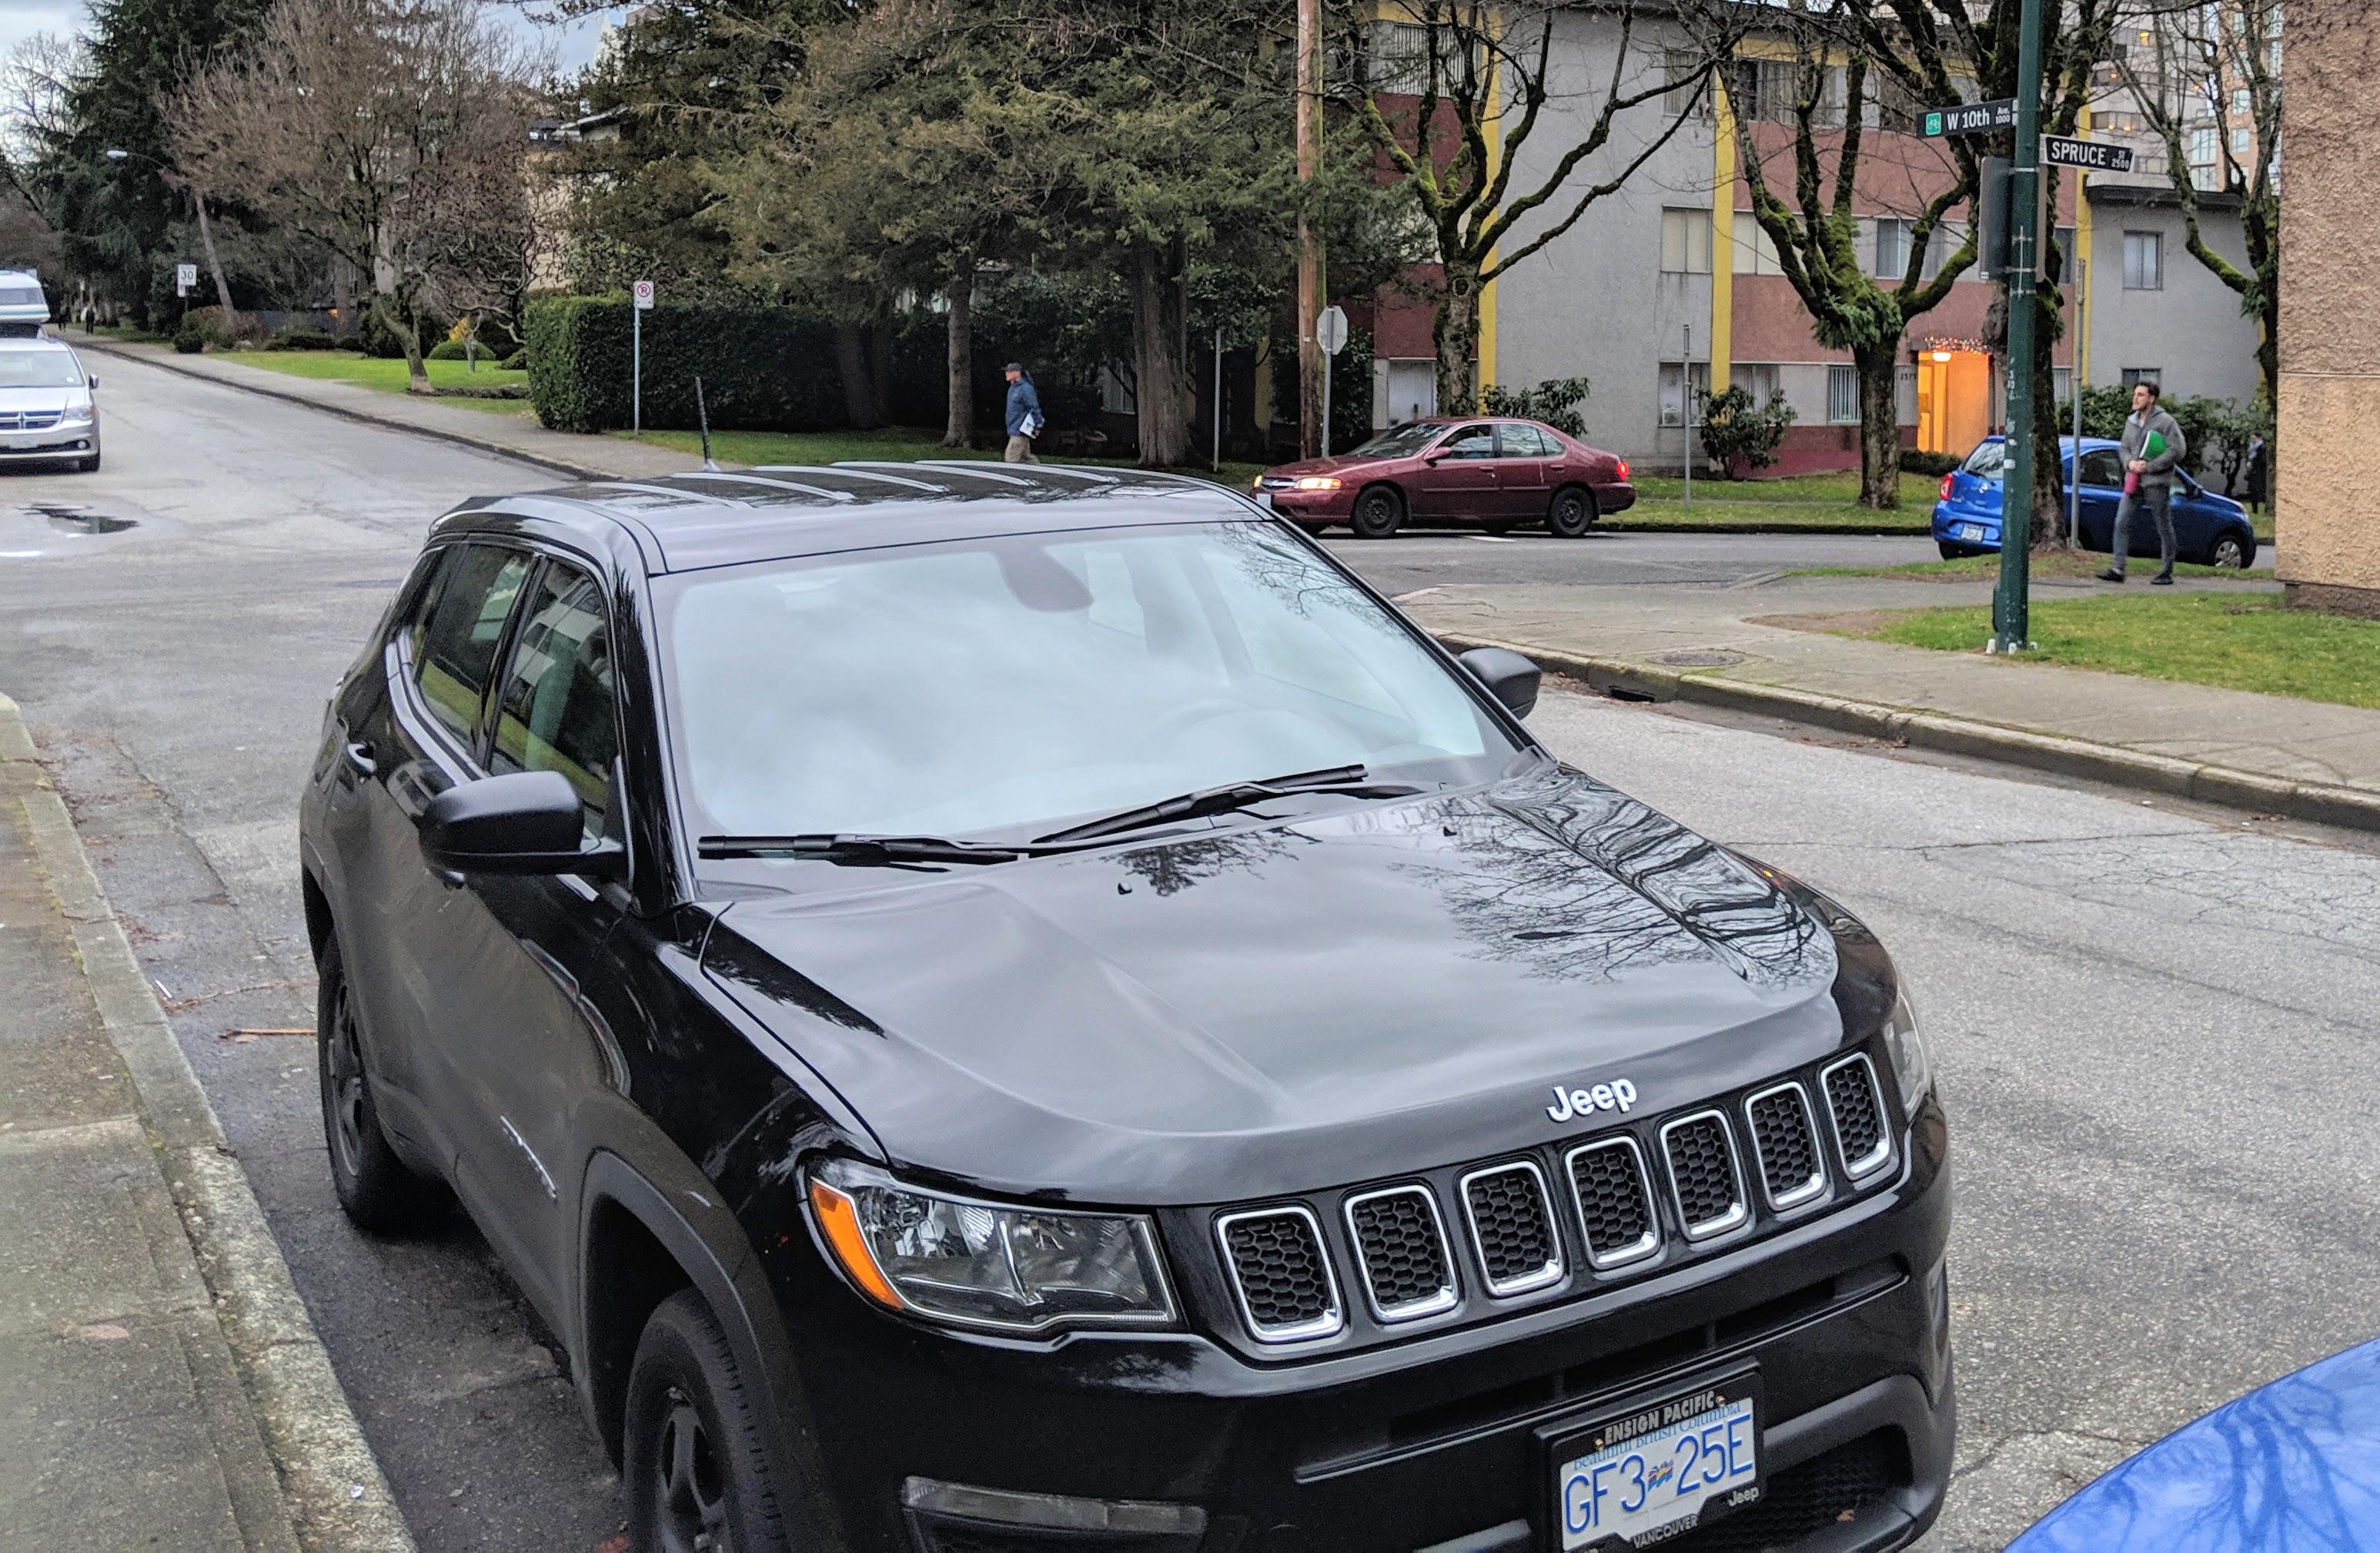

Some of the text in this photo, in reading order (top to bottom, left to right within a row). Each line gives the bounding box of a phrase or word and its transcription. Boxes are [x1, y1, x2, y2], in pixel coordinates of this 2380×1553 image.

[1947, 108, 1991, 131] W 10th
[2051, 140, 2107, 166] SPRUCE
[2111, 157, 2130, 169] 2500
[181, 270, 194, 280] 30
[1546, 1079, 1637, 1123] Jeep
[1604, 1390, 1716, 1445] ENSIGN PACIFIC
[1564, 1413, 1753, 1534] GF3 25E
[1728, 1487, 1760, 1506] Jeep
[1633, 1514, 1699, 1549] VANCOUVER
